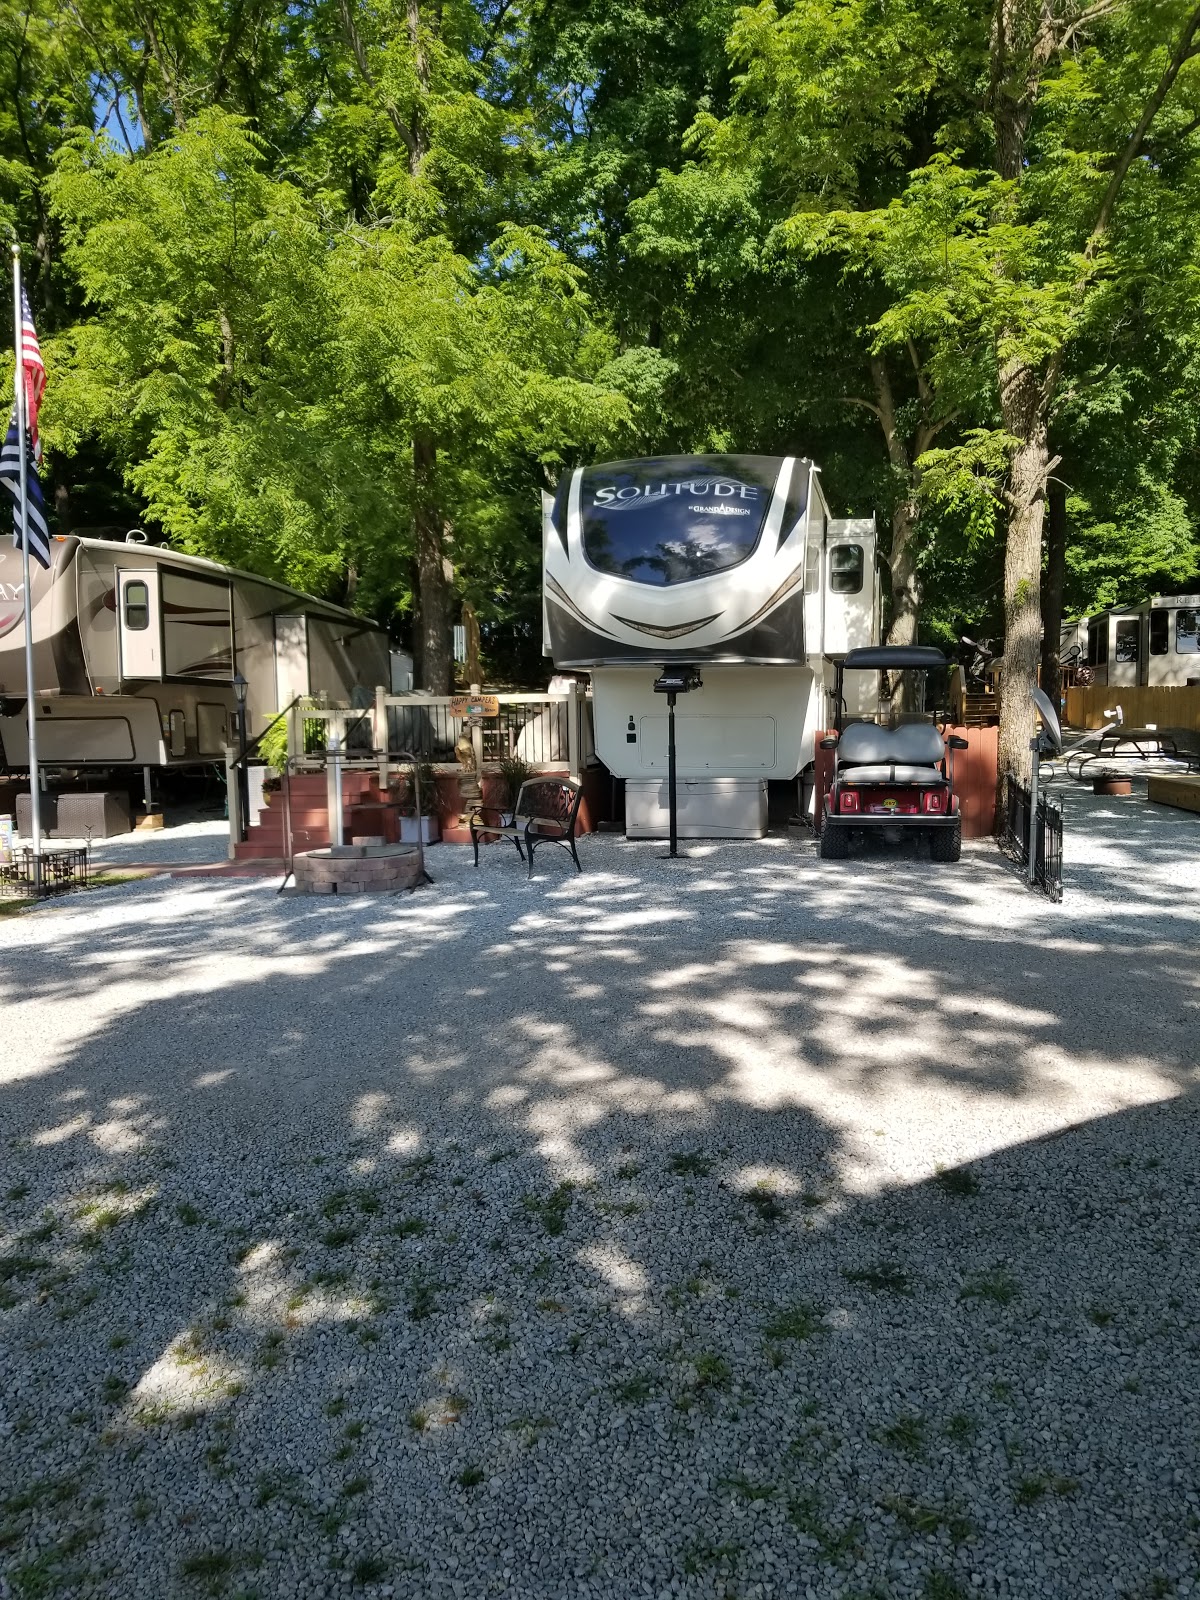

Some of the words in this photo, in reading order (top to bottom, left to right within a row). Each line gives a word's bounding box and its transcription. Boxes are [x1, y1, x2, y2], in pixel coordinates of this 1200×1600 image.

[593, 483, 758, 506] SOLITUDE
[725, 506, 750, 515] DESIGN
[451, 698, 468, 706] HAPPY
